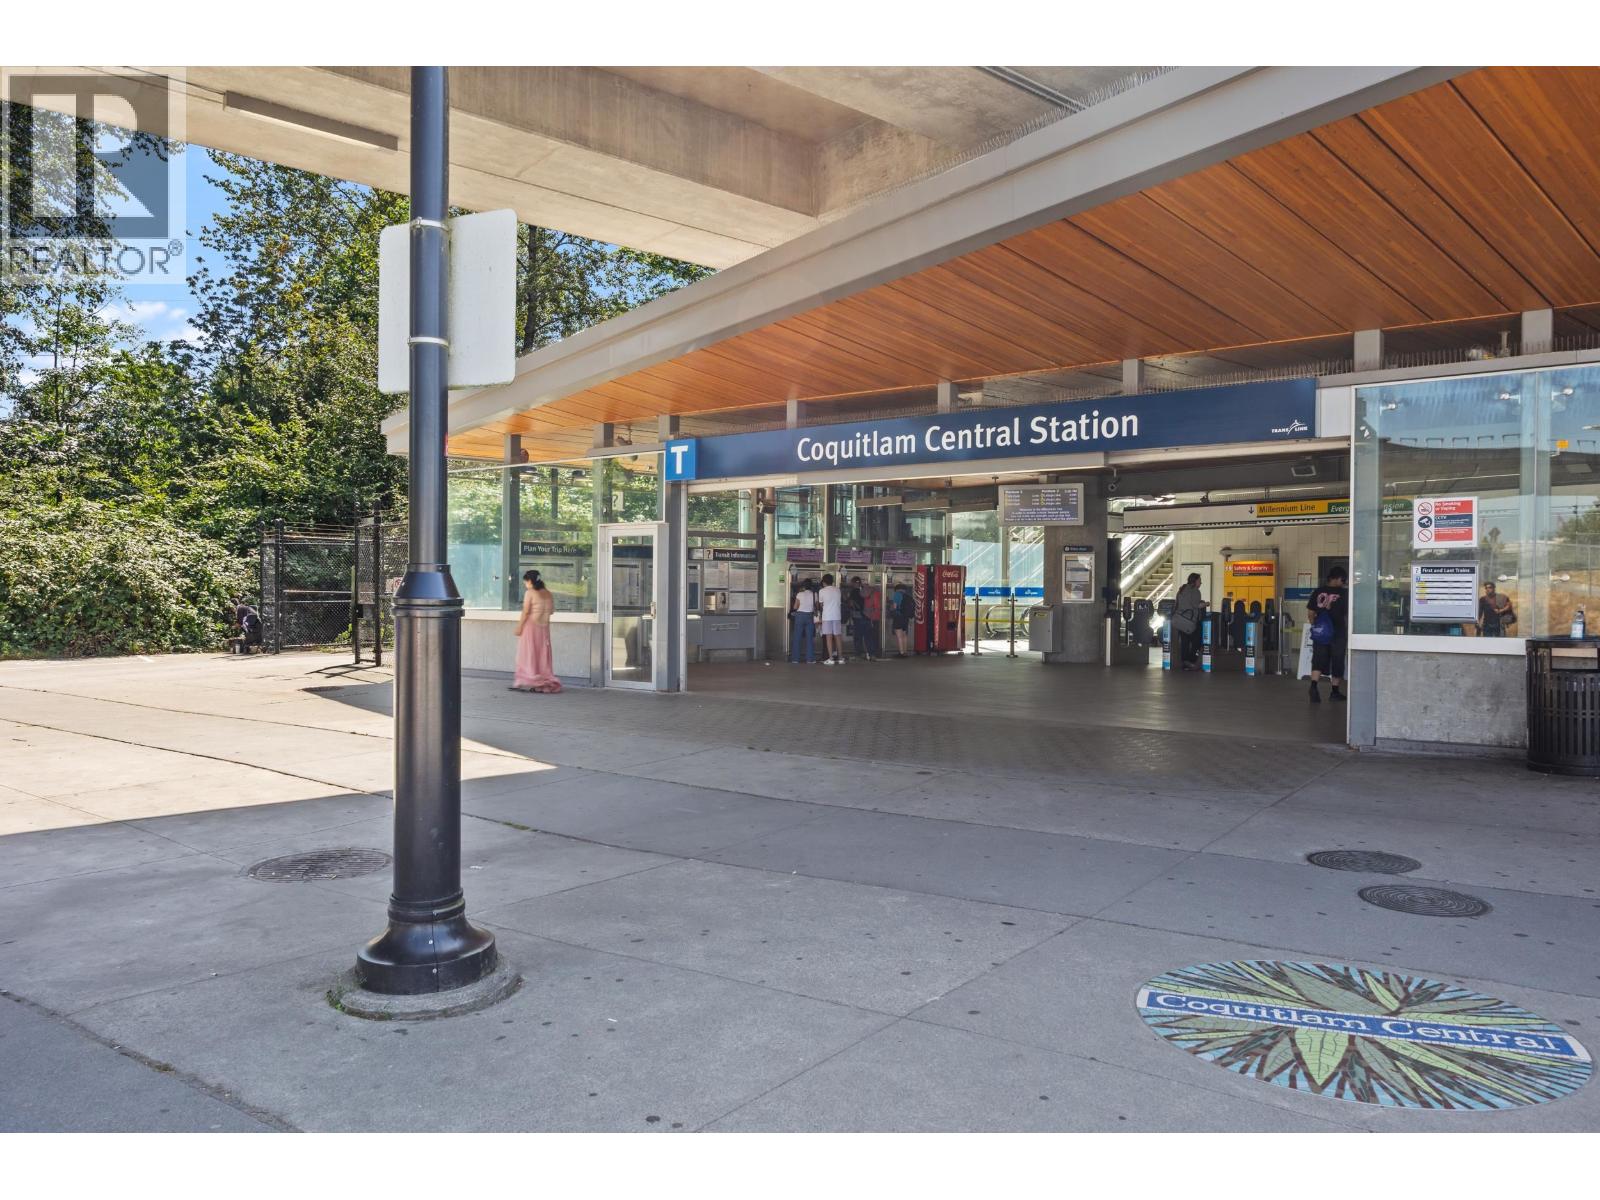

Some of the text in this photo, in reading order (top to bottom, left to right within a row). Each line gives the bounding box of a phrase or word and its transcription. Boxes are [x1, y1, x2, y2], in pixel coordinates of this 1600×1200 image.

[670, 444, 689, 475] T
[797, 409, 1139, 466] Coquitlam Central Station
[1258, 503, 1316, 513] Millennium Line
[1154, 993, 1561, 1052] Coquitlam Central
